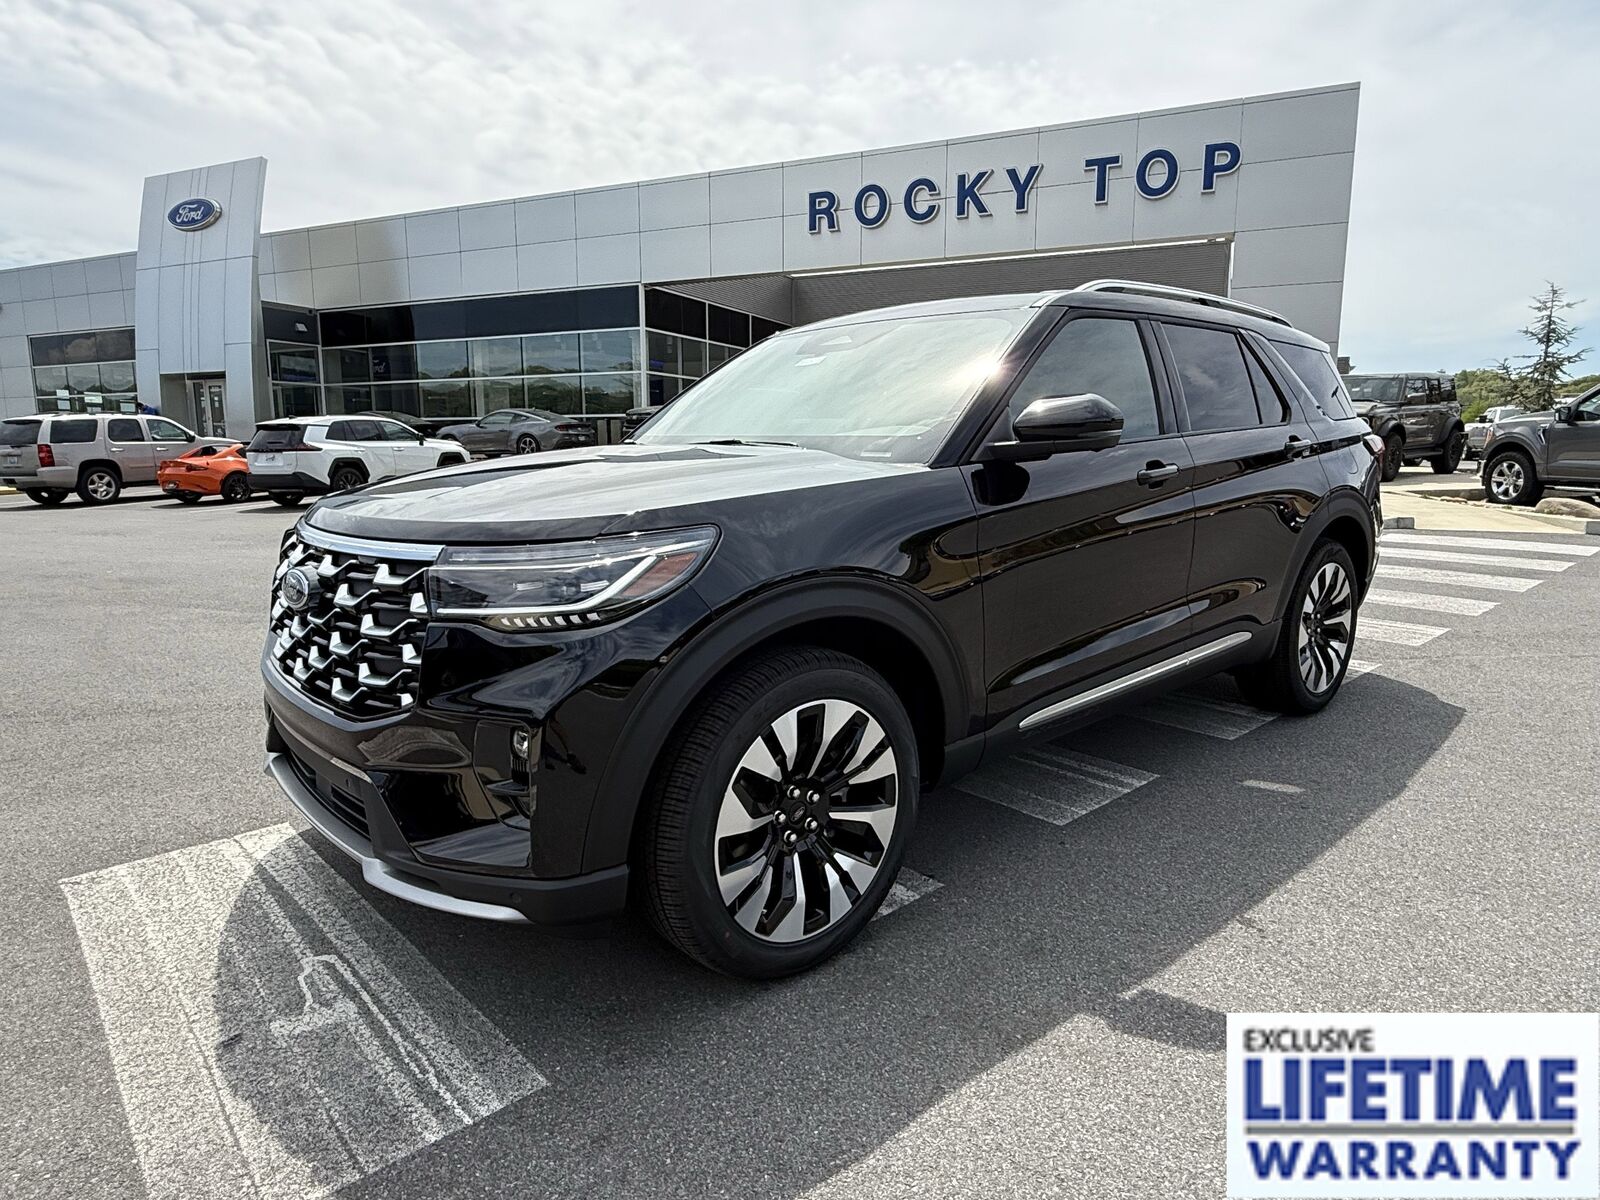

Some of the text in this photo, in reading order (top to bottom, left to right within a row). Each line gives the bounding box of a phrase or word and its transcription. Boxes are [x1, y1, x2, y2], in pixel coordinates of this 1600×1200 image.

[175, 204, 205, 223] Ford
[808, 141, 1242, 233] ROCKY TOP
